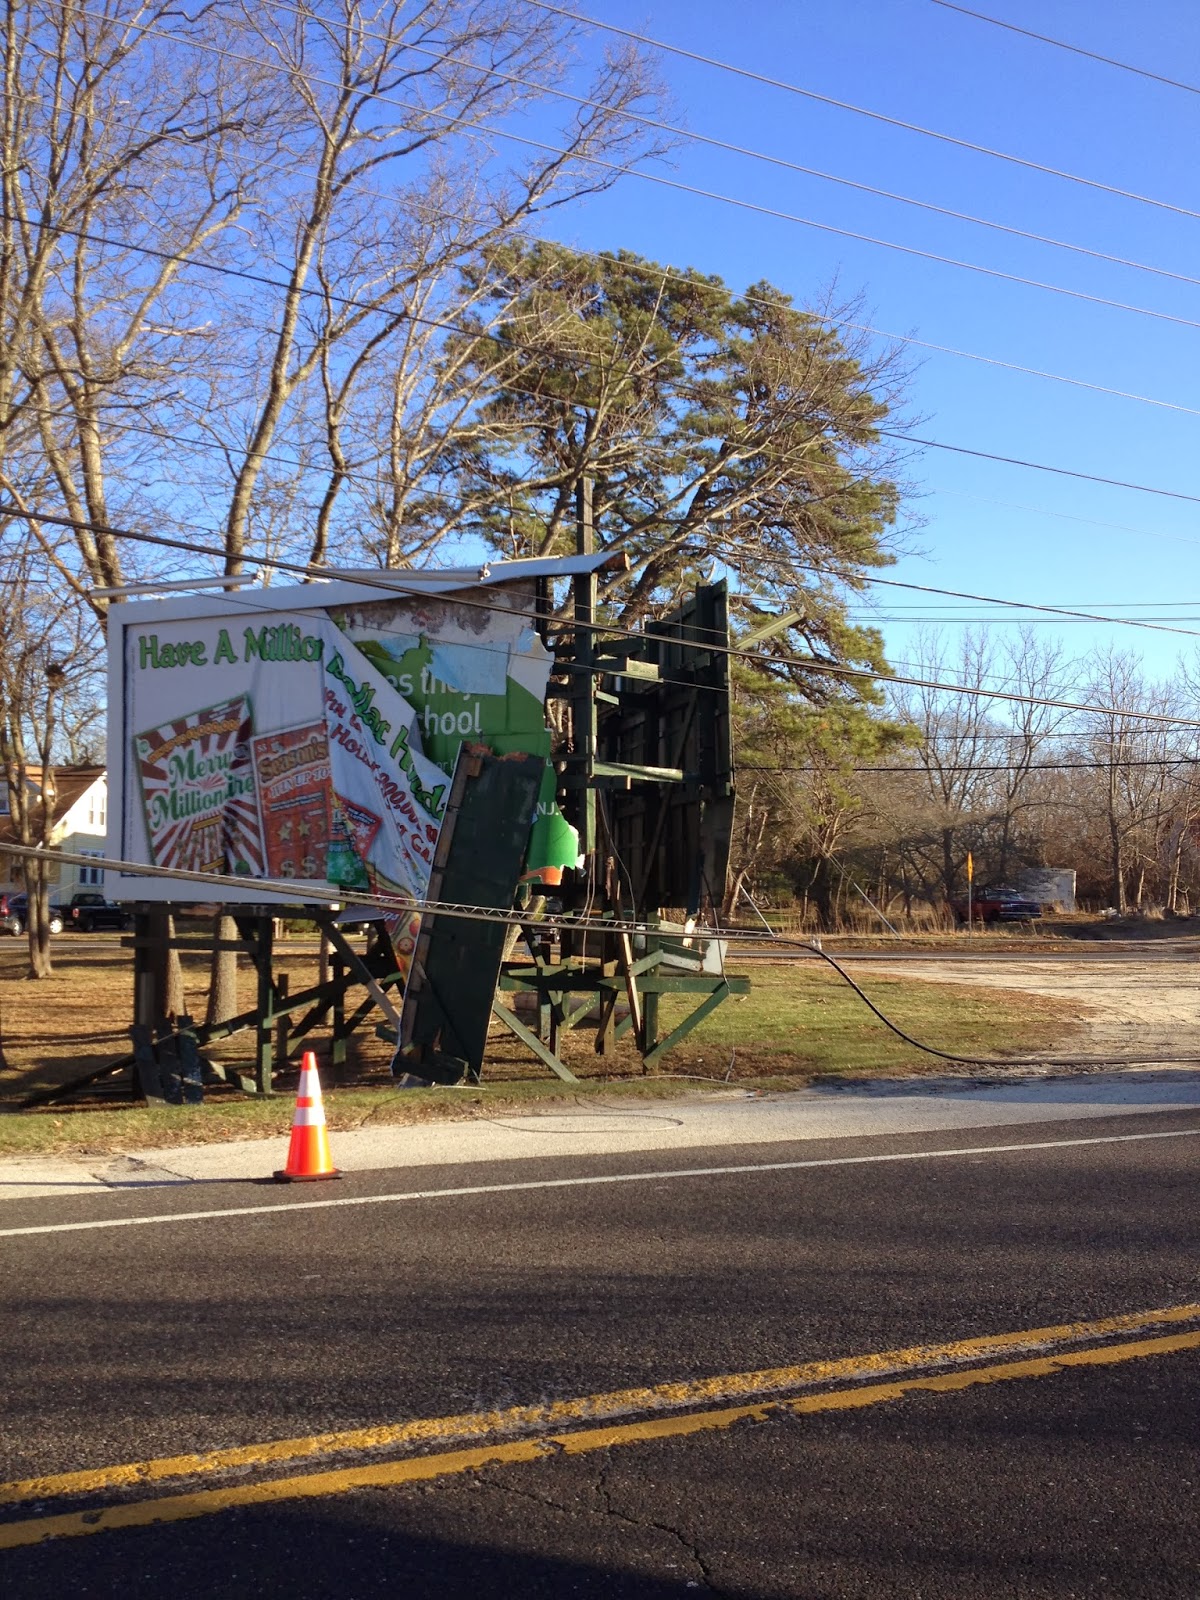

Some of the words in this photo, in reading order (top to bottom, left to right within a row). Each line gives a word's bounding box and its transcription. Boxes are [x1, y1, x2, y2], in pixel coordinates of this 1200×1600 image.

[138, 634, 208, 669] Have
[213, 629, 238, 665] A
[168, 748, 232, 790] Merry
